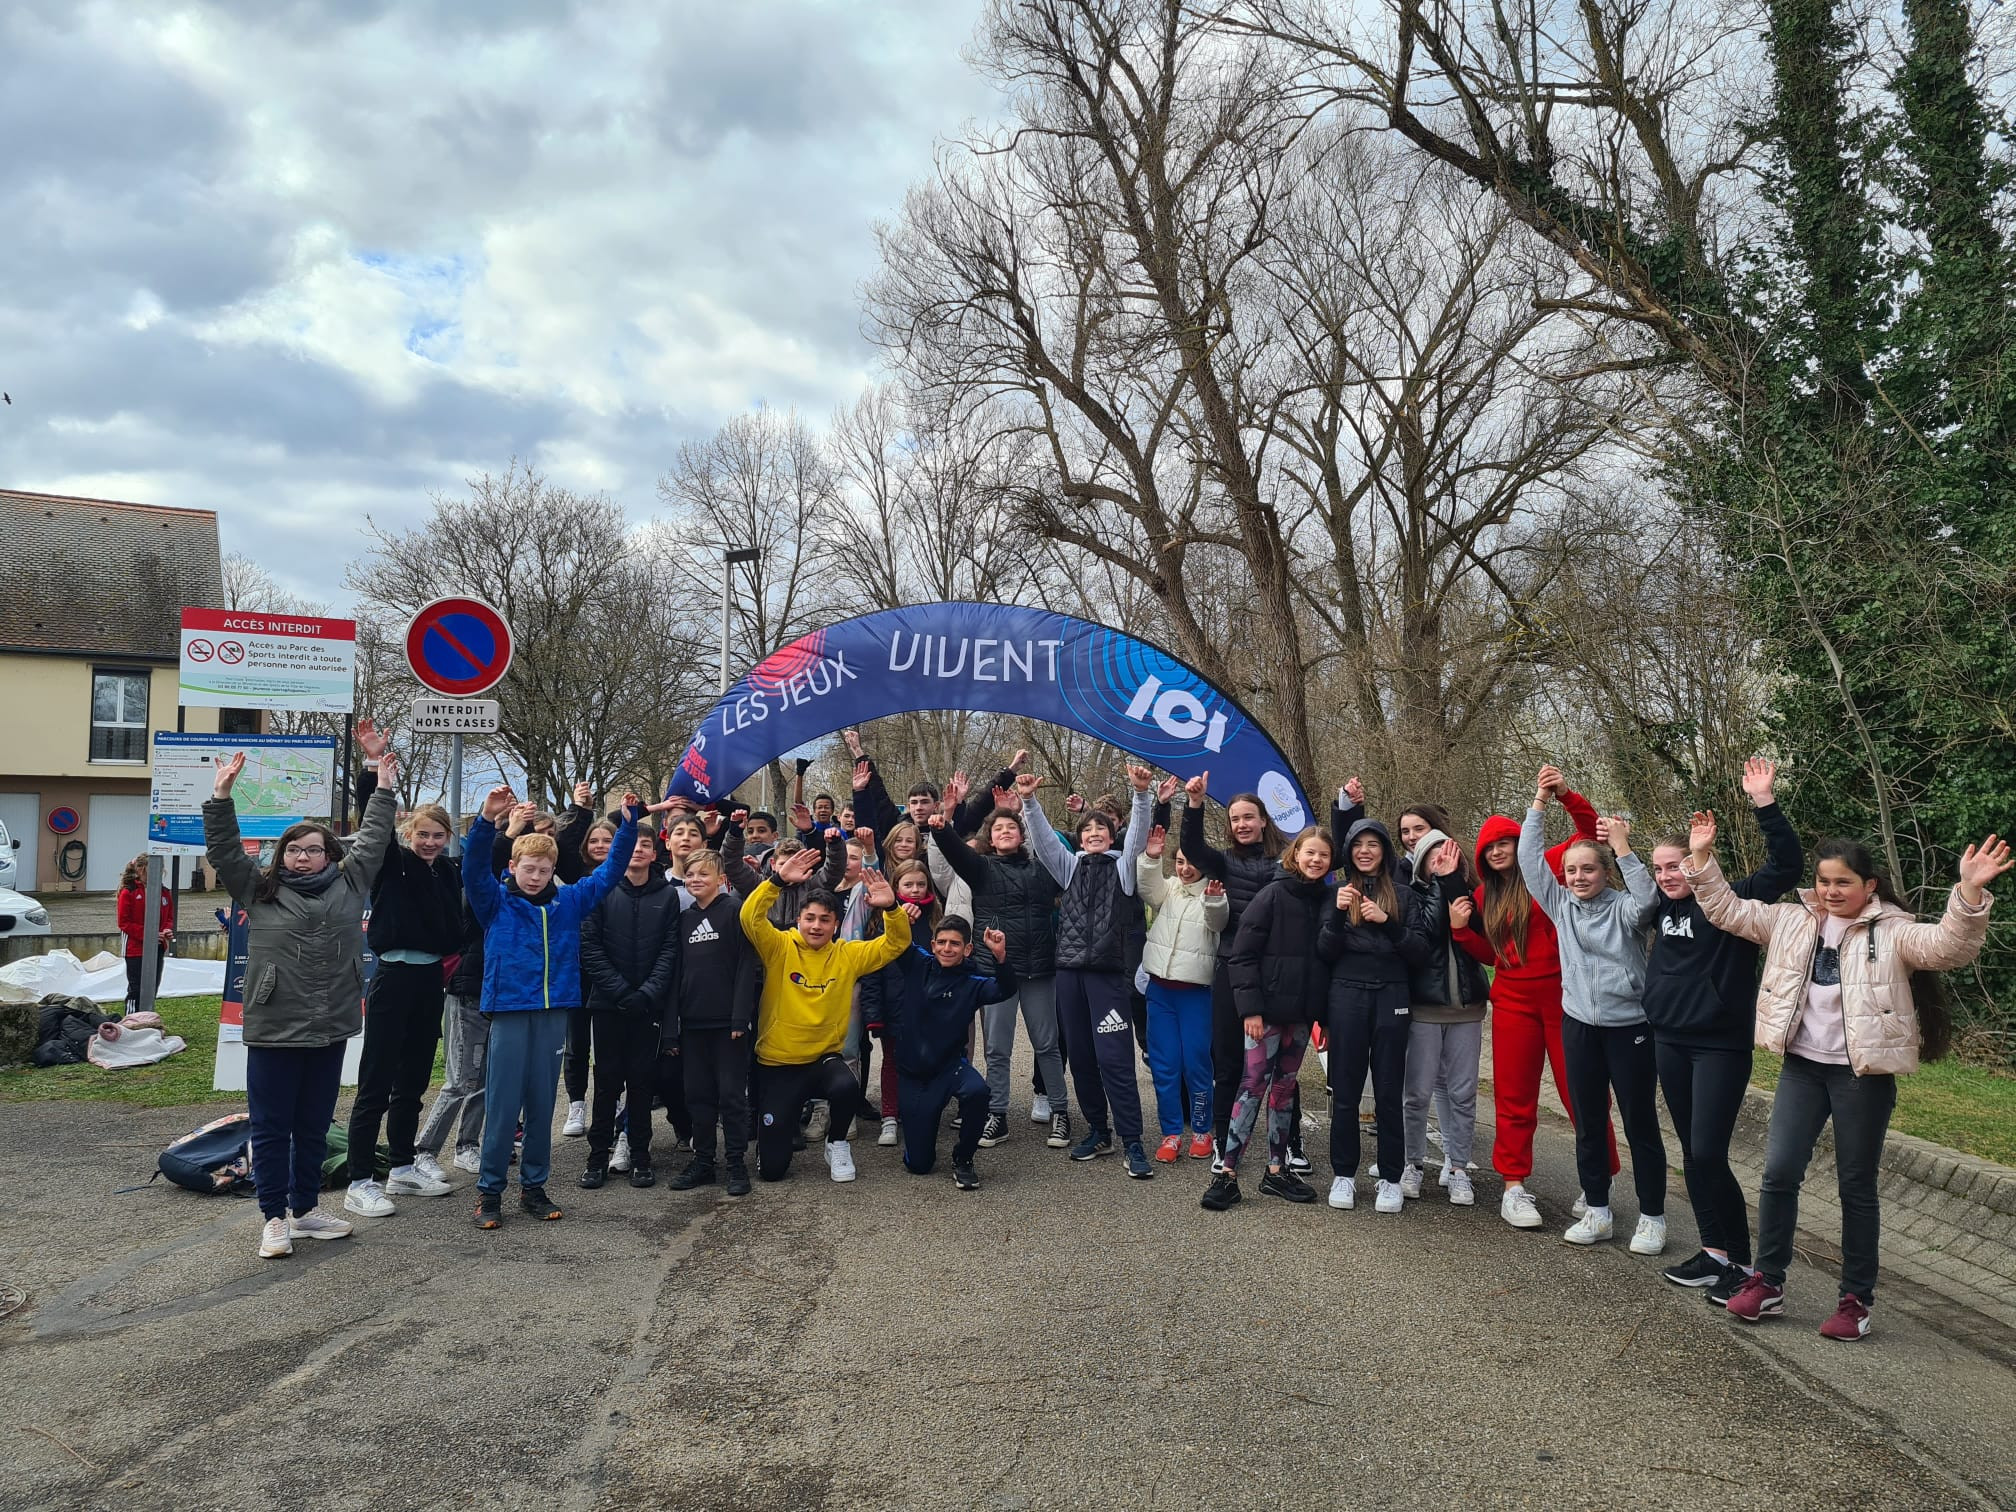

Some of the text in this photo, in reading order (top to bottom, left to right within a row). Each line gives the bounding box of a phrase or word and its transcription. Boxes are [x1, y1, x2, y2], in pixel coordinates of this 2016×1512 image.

[224, 618, 323, 635] ACCÈS INTERDIT
[249, 641, 274, 650] Accès
[290, 643, 309, 652] Parc
[310, 644, 325, 653] des
[248, 651, 276, 660] Sports
[278, 651, 311, 662] interdit
[320, 655, 342, 663] toute
[247, 661, 288, 669] personne
[308, 663, 348, 673] autorisée
[722, 650, 858, 736] LES JEUX
[426, 704, 485, 715] INTERDIT
[1125, 674, 1229, 754] ICI
[416, 718, 495, 728] HORS CASES
[689, 931, 720, 944] adidas
[1096, 1022, 1129, 1034] adidas
